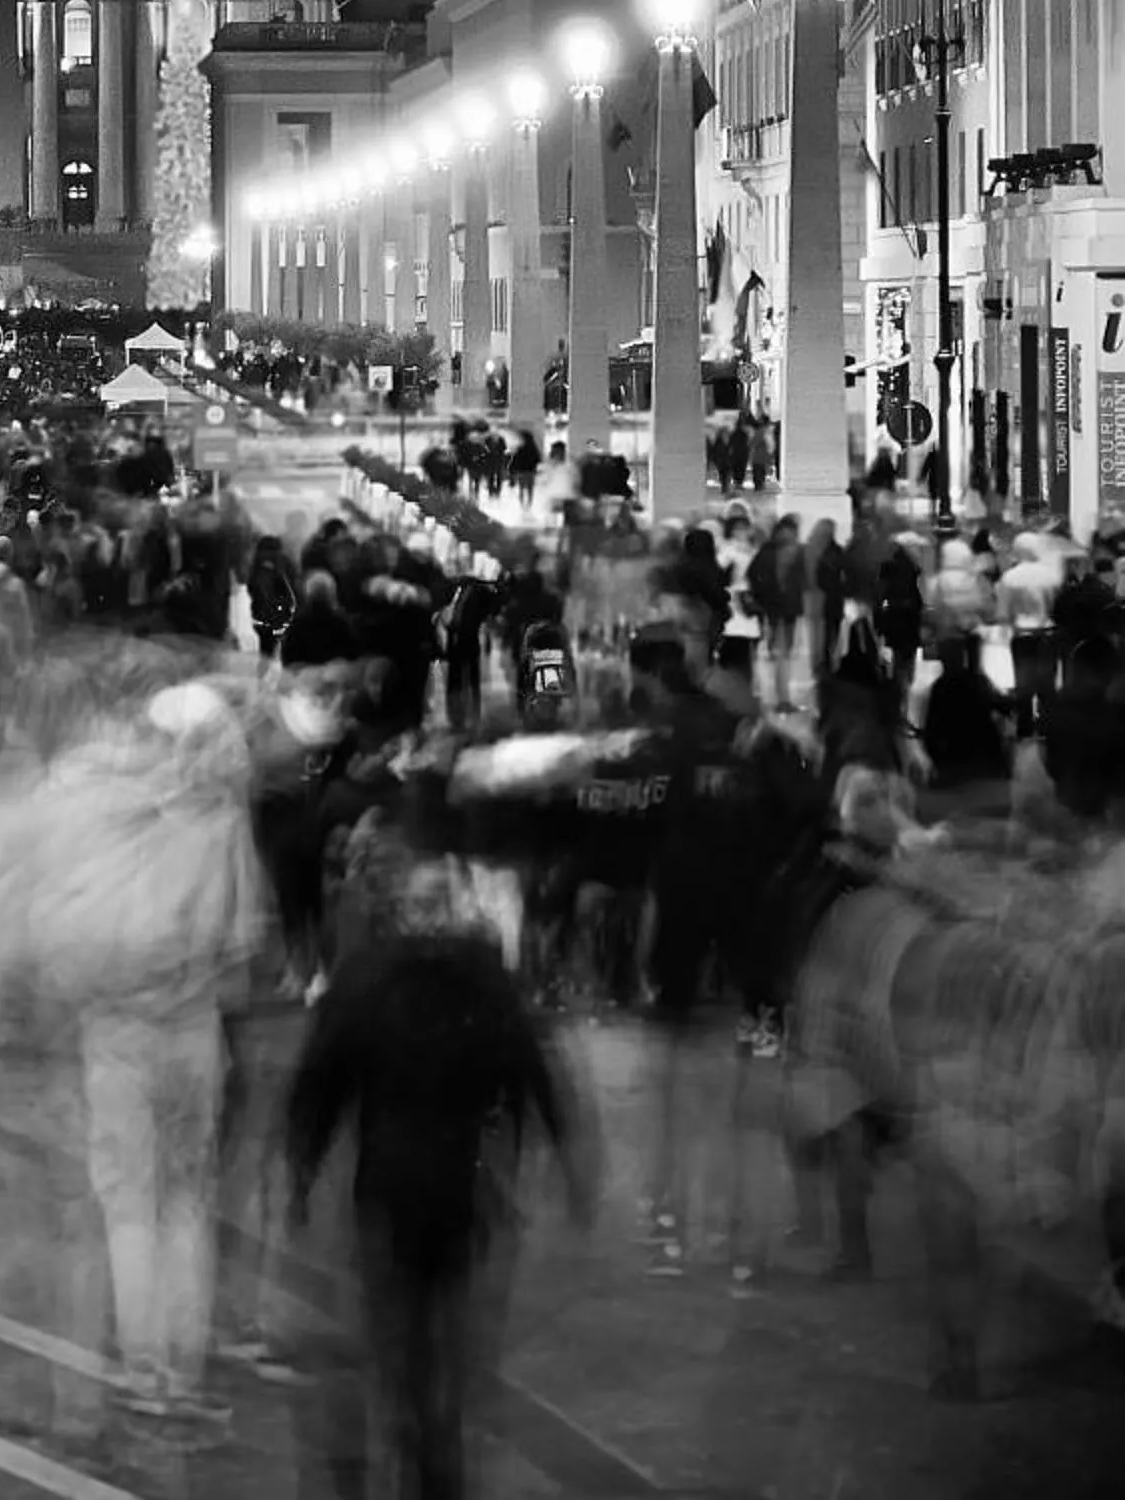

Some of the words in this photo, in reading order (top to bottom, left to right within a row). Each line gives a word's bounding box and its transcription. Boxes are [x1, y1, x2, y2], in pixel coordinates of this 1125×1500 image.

[1054, 337, 1067, 413] INFOPOINT
[1056, 419, 1068, 475] TOURIST
[1101, 379, 1114, 486] TOURIST
[1115, 379, 1125, 488] INFOPOINT
